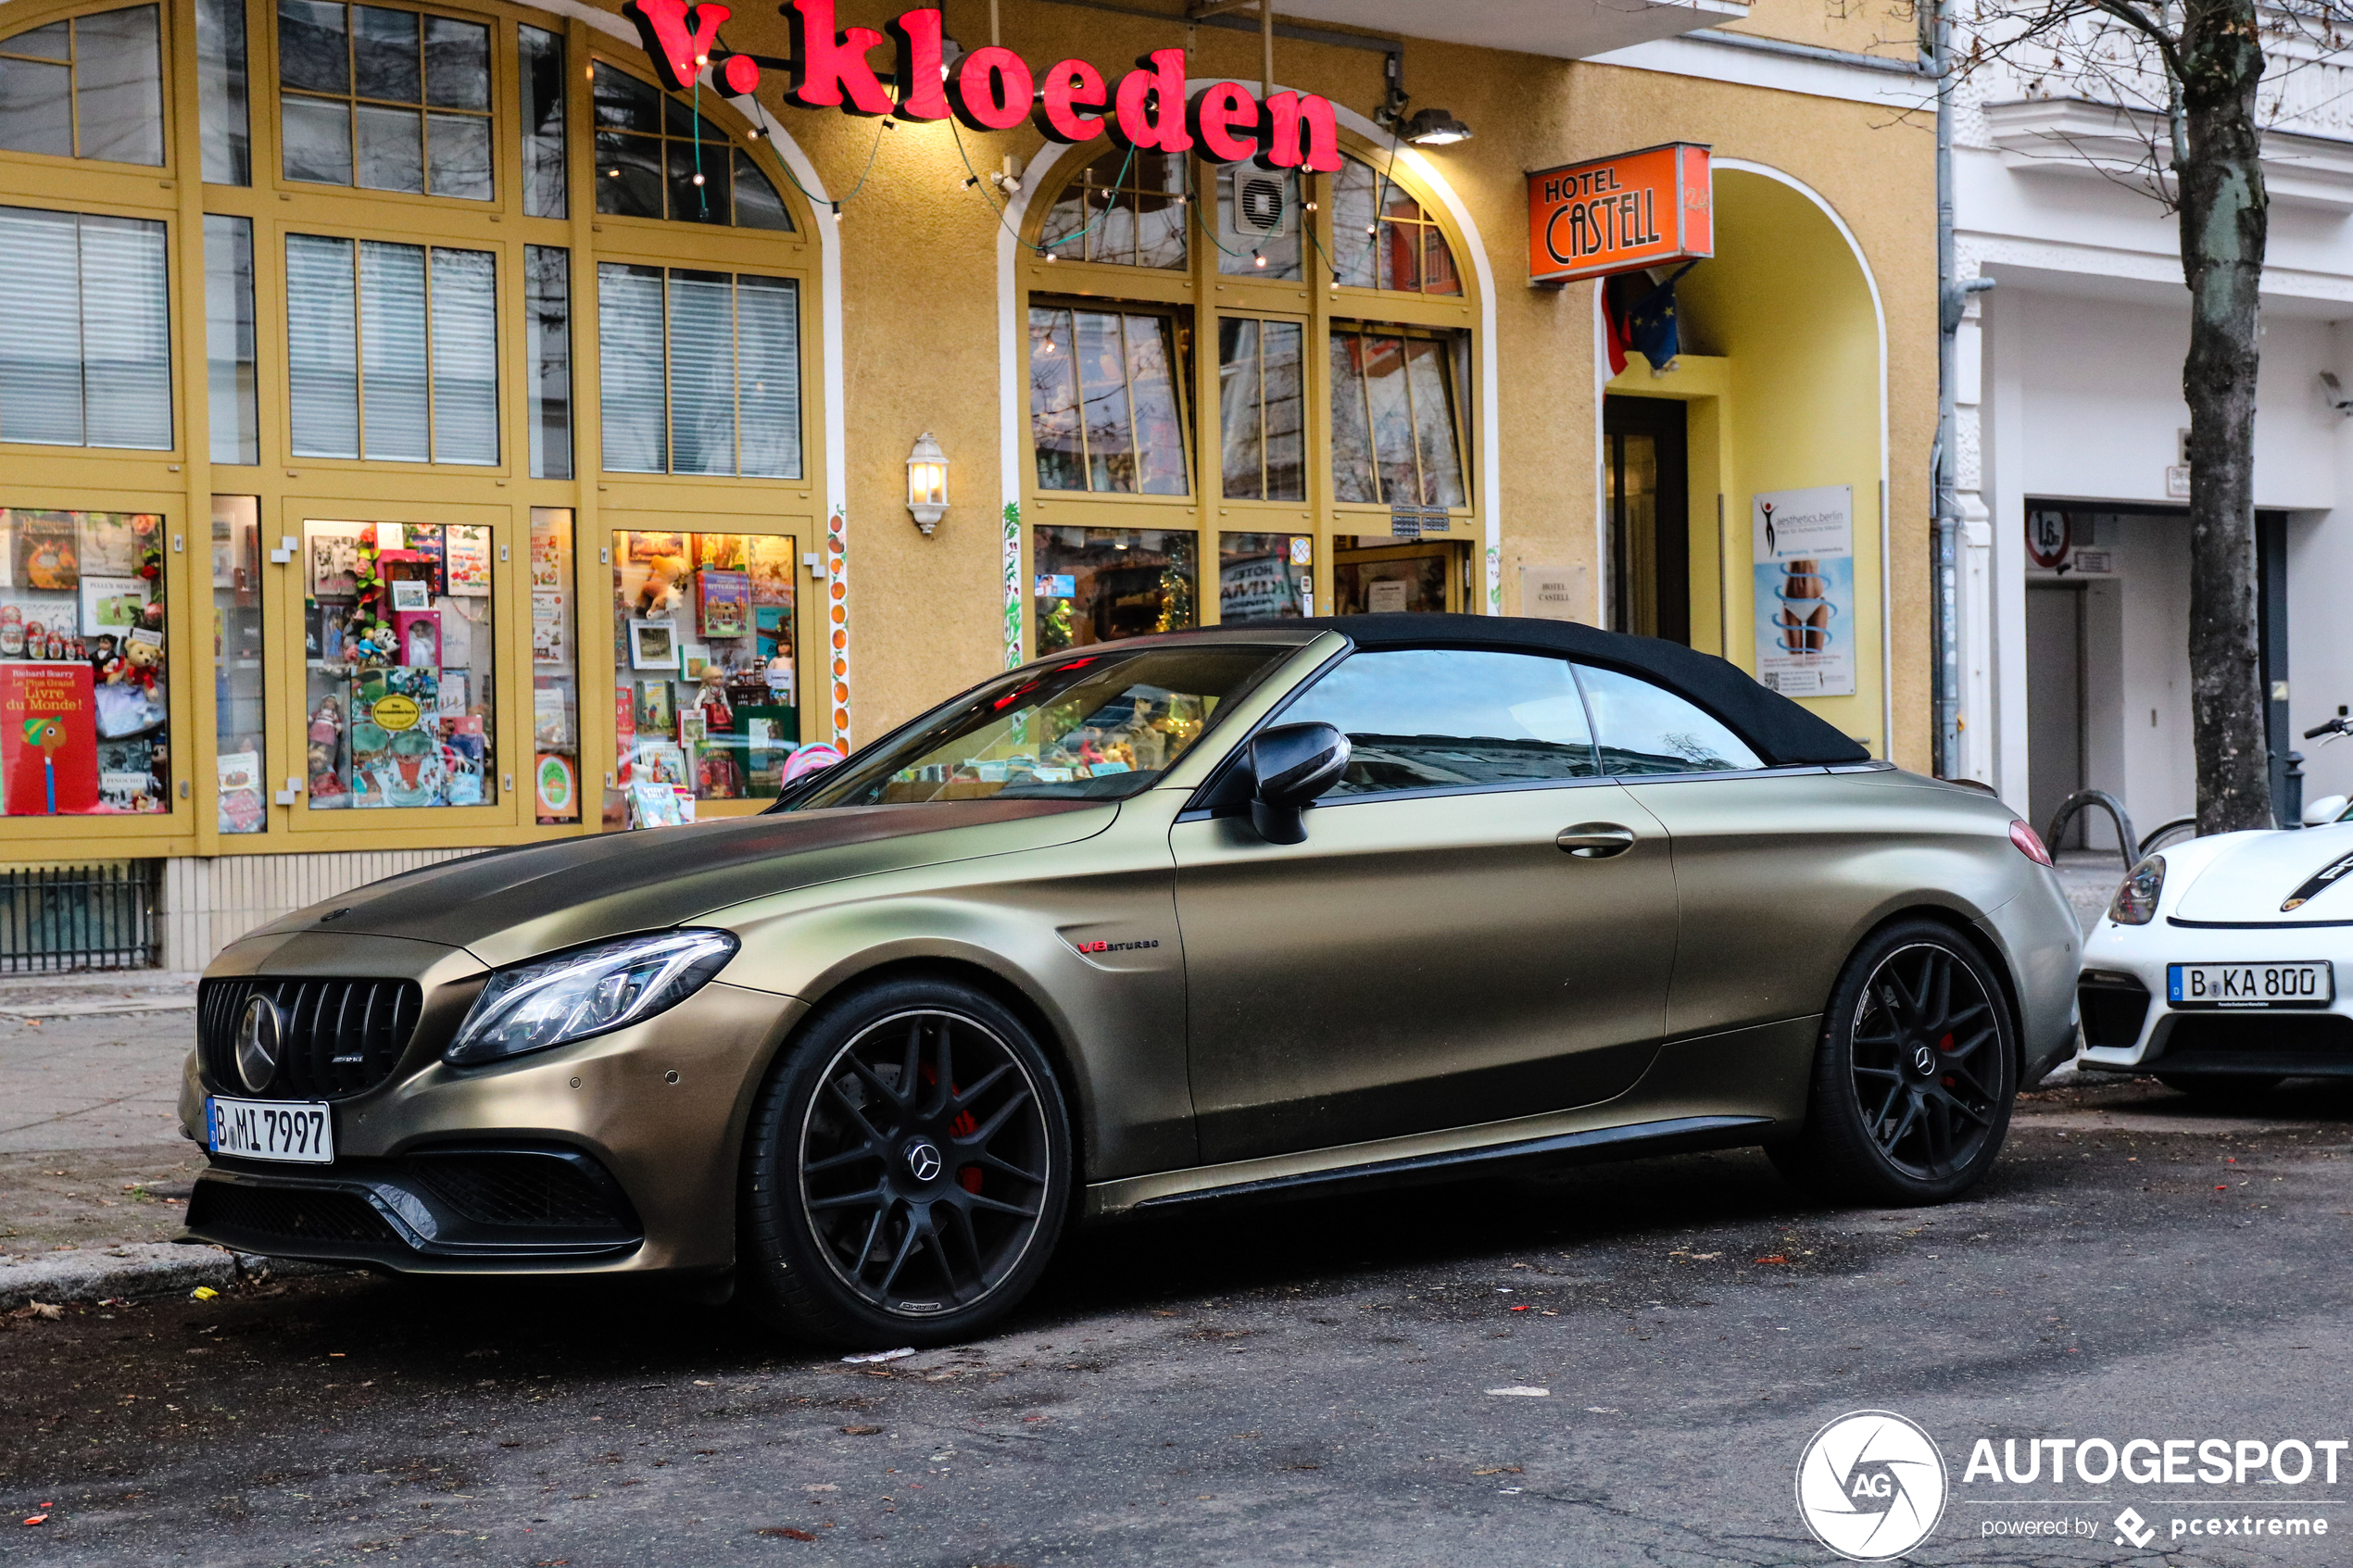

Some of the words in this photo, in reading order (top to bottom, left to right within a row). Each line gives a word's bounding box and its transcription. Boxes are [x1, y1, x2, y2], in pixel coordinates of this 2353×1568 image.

[786, 0, 1342, 173] kloeden
[1544, 167, 1621, 204] HOTEL
[1545, 188, 1661, 265] CASTELL
[26, 679, 44, 687] Plus
[47, 679, 75, 687] Grand
[46, 670, 74, 678] Scarry
[25, 687, 65, 699] Livre
[6, 699, 24, 710] du
[1077, 940, 1108, 954] V8
[1107, 940, 1160, 952] BITURBO
[2191, 970, 2207, 997] B
[2223, 969, 2258, 997] KA
[2265, 968, 2315, 996] 800
[216, 1105, 228, 1147] B
[234, 1107, 261, 1152] MI
[264, 1110, 324, 1154] 7997
